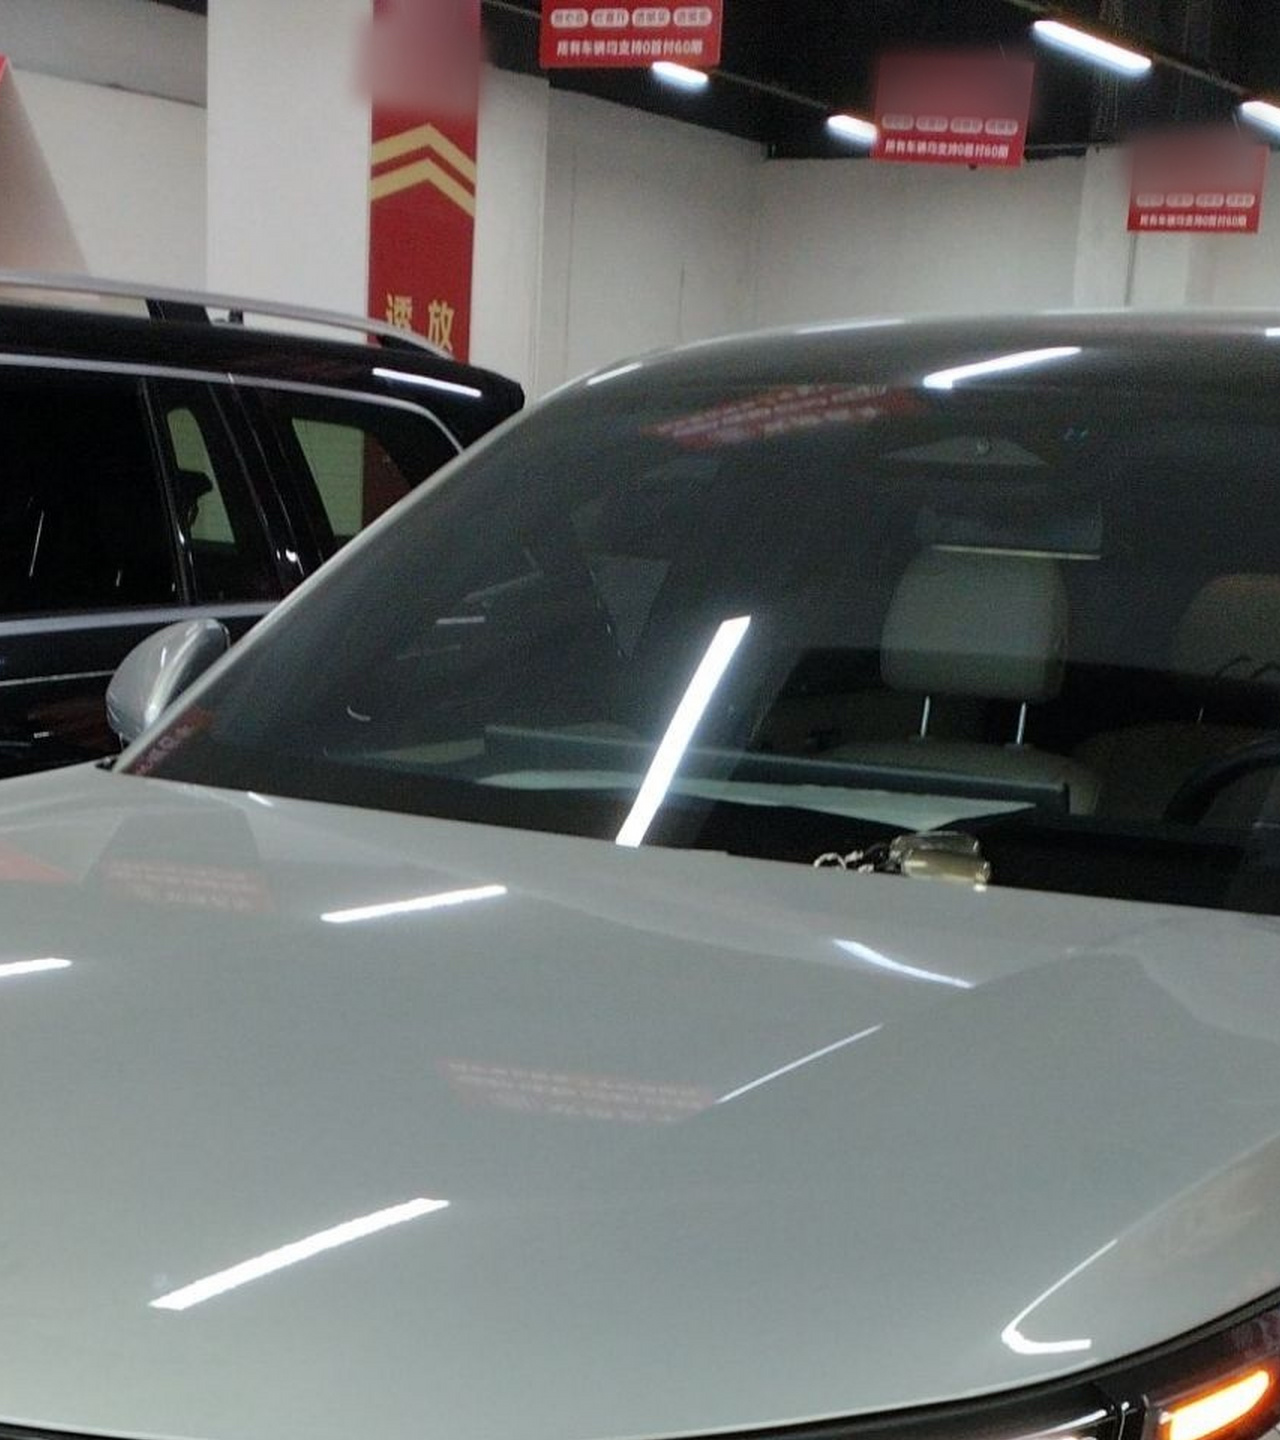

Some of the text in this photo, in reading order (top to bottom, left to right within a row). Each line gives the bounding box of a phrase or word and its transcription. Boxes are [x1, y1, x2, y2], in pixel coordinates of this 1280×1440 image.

[557, 38, 703, 57] 所有车辆均支持0首付60期
